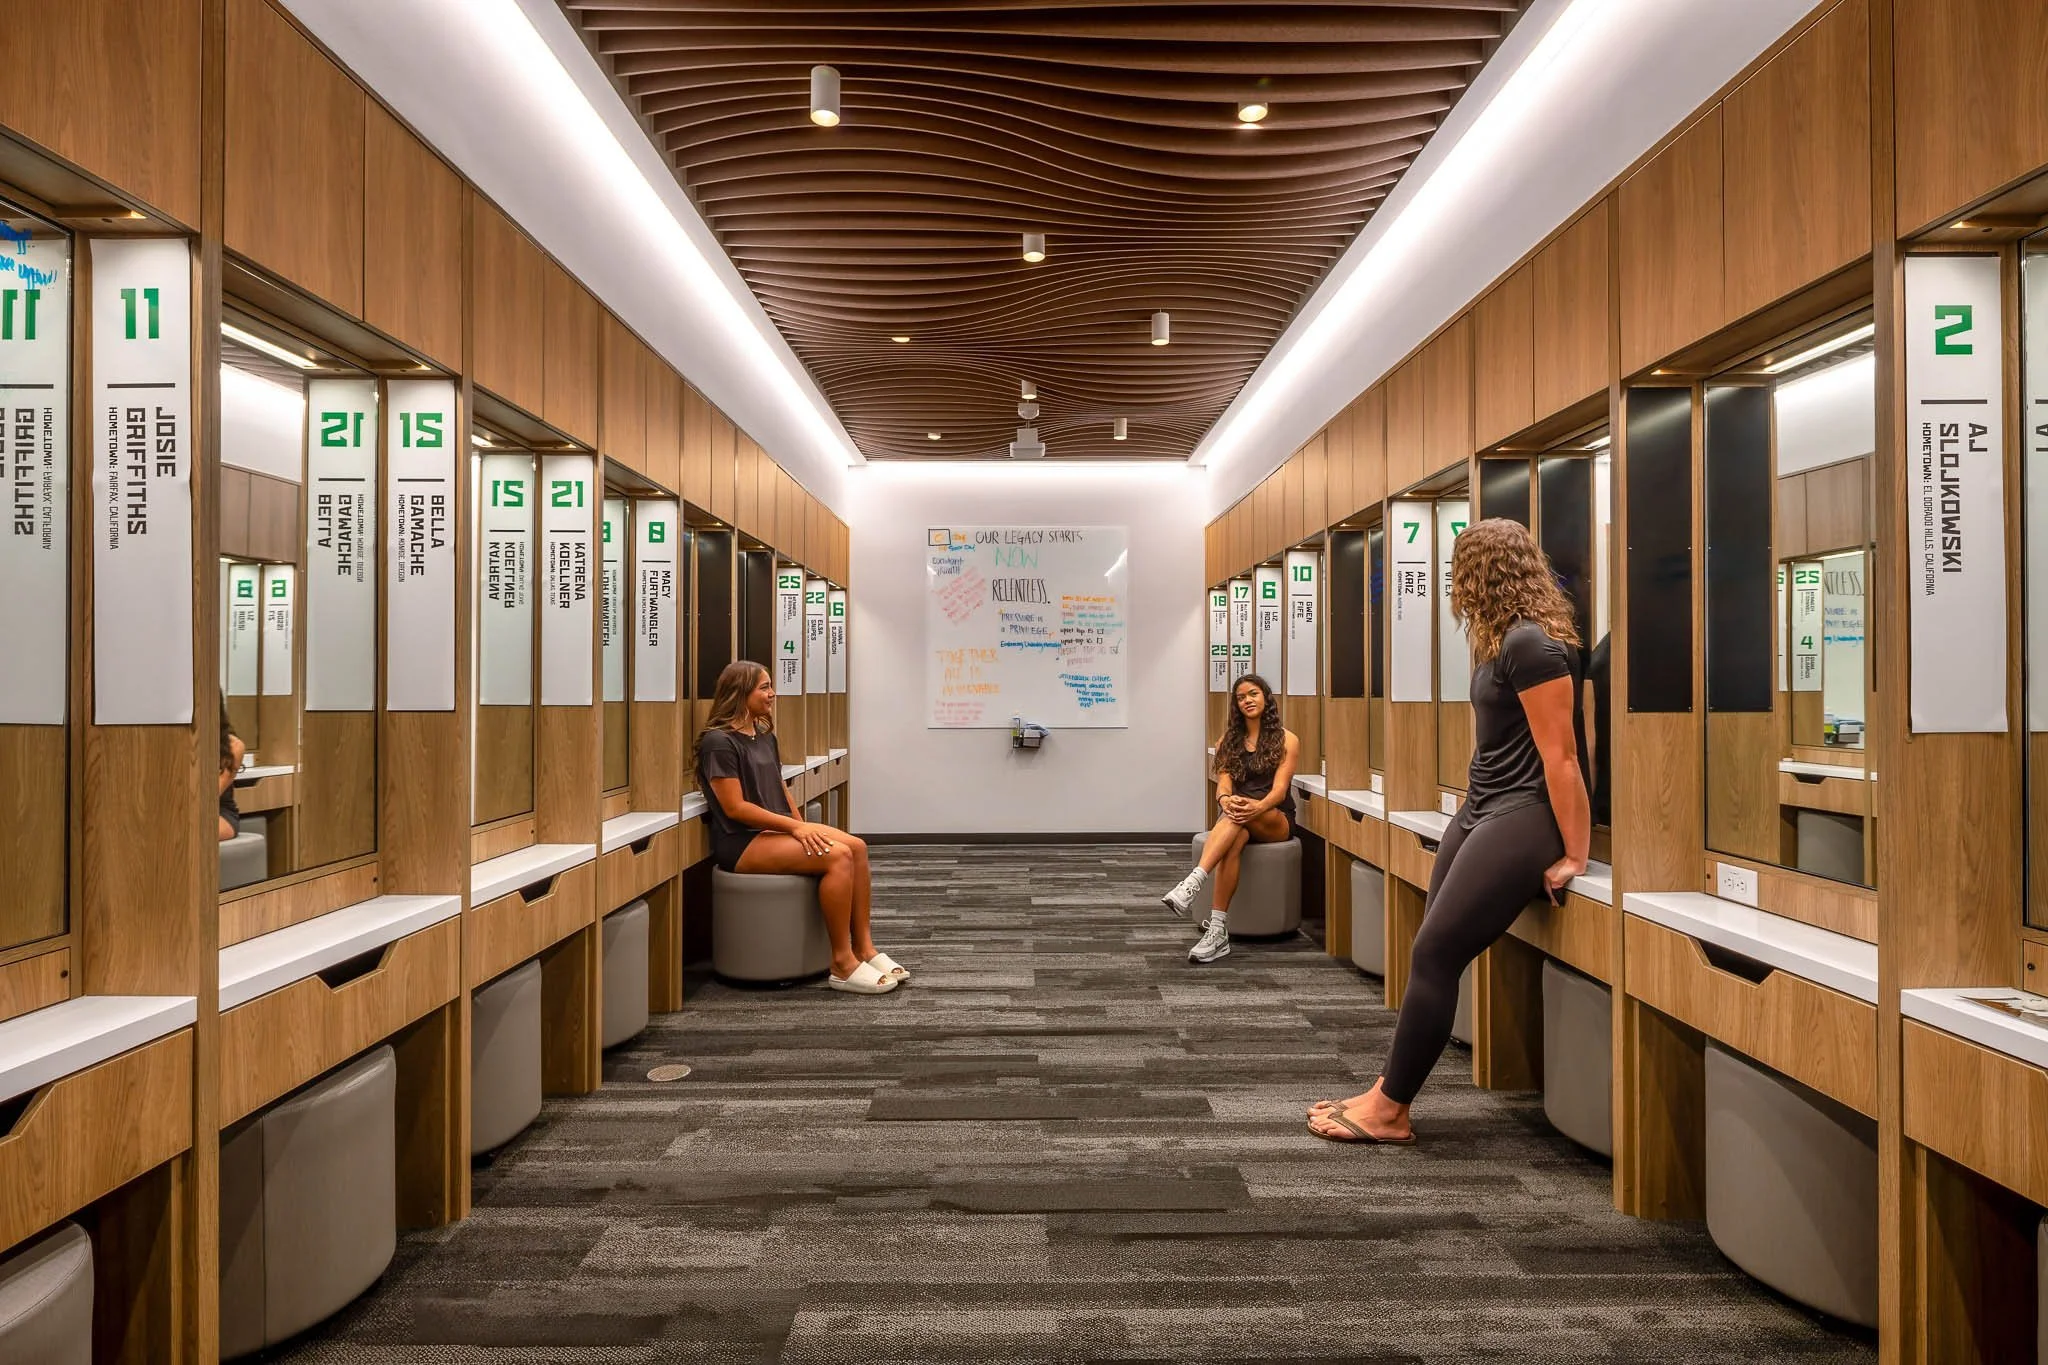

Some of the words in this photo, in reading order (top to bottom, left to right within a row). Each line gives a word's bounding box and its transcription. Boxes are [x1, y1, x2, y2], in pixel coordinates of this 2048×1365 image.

[120, 287, 159, 340] 11
[1934, 304, 1973, 356] 2
[108, 406, 118, 469] HOMETOWN:
[155, 406, 177, 478] JOSIE
[399, 412, 443, 448] 15
[1968, 422, 1988, 453] AJ
[1922, 422, 1932, 483] HOMETOWN:
[126, 407, 147, 535] GRIFFITHS
[108, 471, 119, 504] FAIRFAX,
[551, 480, 584, 508] 21
[1923, 485, 1933, 495] EL
[1939, 423, 1962, 574] SLOJKOWSKI
[431, 494, 445, 549] BELLA
[1924, 497, 1934, 527] DORADO
[109, 506, 119, 550] CALIFORNIA
[410, 494, 425, 576] GAMACHE
[648, 521, 665, 543] 8
[975, 530, 999, 545] OUR
[1004, 530, 1043, 545] LEGACY
[1048, 529, 1083, 543] STARTS
[1403, 522, 1420, 544] 7
[575, 542, 586, 601] KATRENA
[995, 546, 1039, 569] NOW
[559, 542, 570, 609] KOELLNER
[661, 570, 671, 599] MACY
[778, 575, 801, 589] 25
[1292, 565, 1312, 582] 10
[1405, 571, 1414, 594] KRIZ
[1417, 571, 1426, 597] ALEX
[1925, 553, 1936, 596] CALIFORNIA
[806, 591, 825, 604] 22
[992, 578, 1051, 604] RELENTLESS.
[1234, 586, 1249, 599] 17
[1262, 581, 1276, 599] 6
[648, 570, 659, 647] FURTWANGLER
[783, 640, 795, 654] 4
[1232, 644, 1251, 657] 33
[1800, 636, 1813, 649] 4
